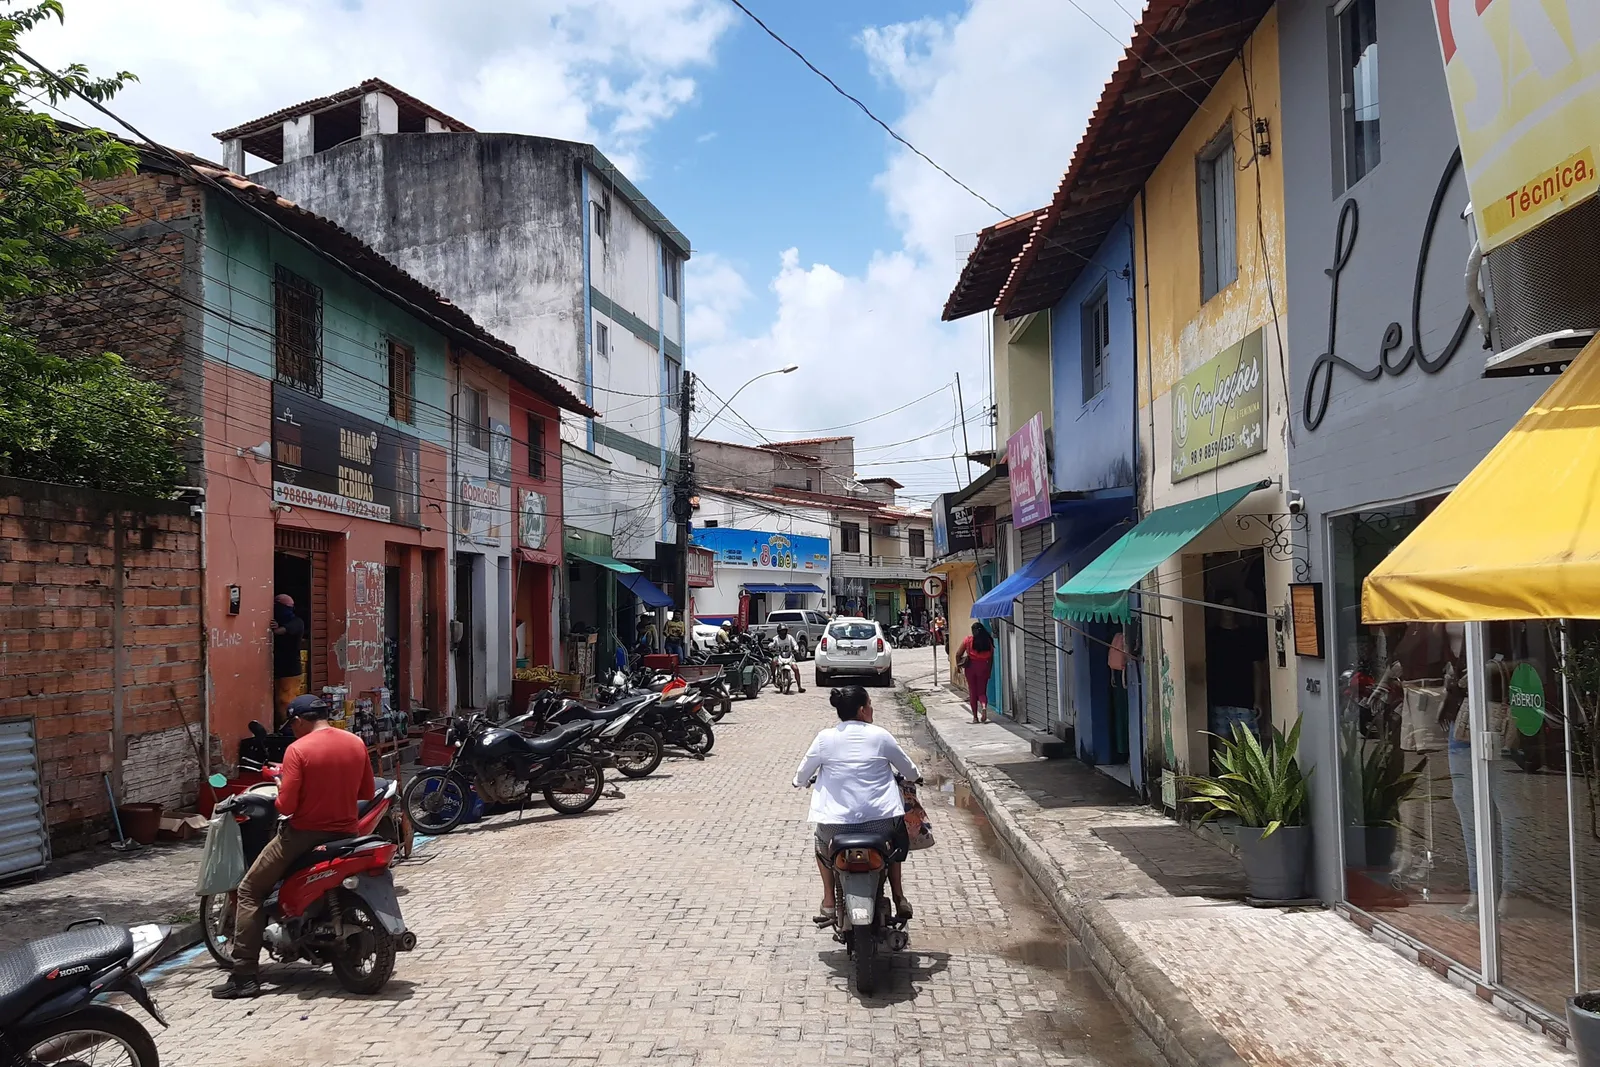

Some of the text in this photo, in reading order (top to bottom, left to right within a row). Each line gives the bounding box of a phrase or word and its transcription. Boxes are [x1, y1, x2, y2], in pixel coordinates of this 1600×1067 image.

[1505, 158, 1595, 219] Técnica,
[1192, 355, 1260, 437] Confecções
[340, 427, 371, 466] RAMOS
[338, 464, 374, 502] BEBIDAS
[462, 481, 499, 506] RODRIGUES
[1510, 693, 1542, 708] ABERTO
[59, 964, 91, 978] HONDA
